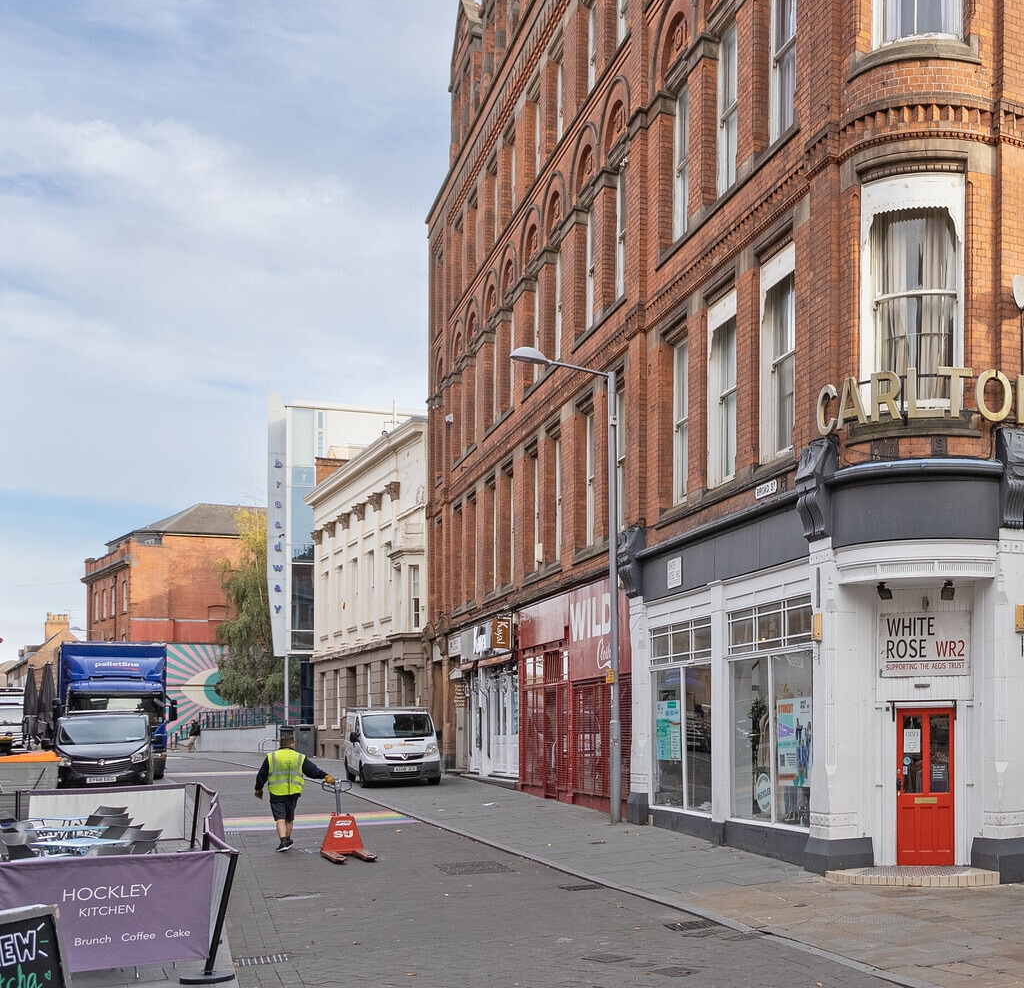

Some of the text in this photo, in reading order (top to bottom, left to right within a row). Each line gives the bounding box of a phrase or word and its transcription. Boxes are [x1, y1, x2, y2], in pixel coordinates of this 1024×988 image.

[272, 458, 283, 613] broadway
[570, 592, 611, 642] WILD
[886, 617, 935, 637] WHITE
[494, 620, 508, 644] Kayal
[886, 639, 965, 658] ROSE WR2
[62, 883, 152, 902] HOCKLEY
[78, 904, 136, 917] KITCHEN
[74, 928, 191, 946] Brunch Coffee Cake
[0, 930, 36, 966] EW
